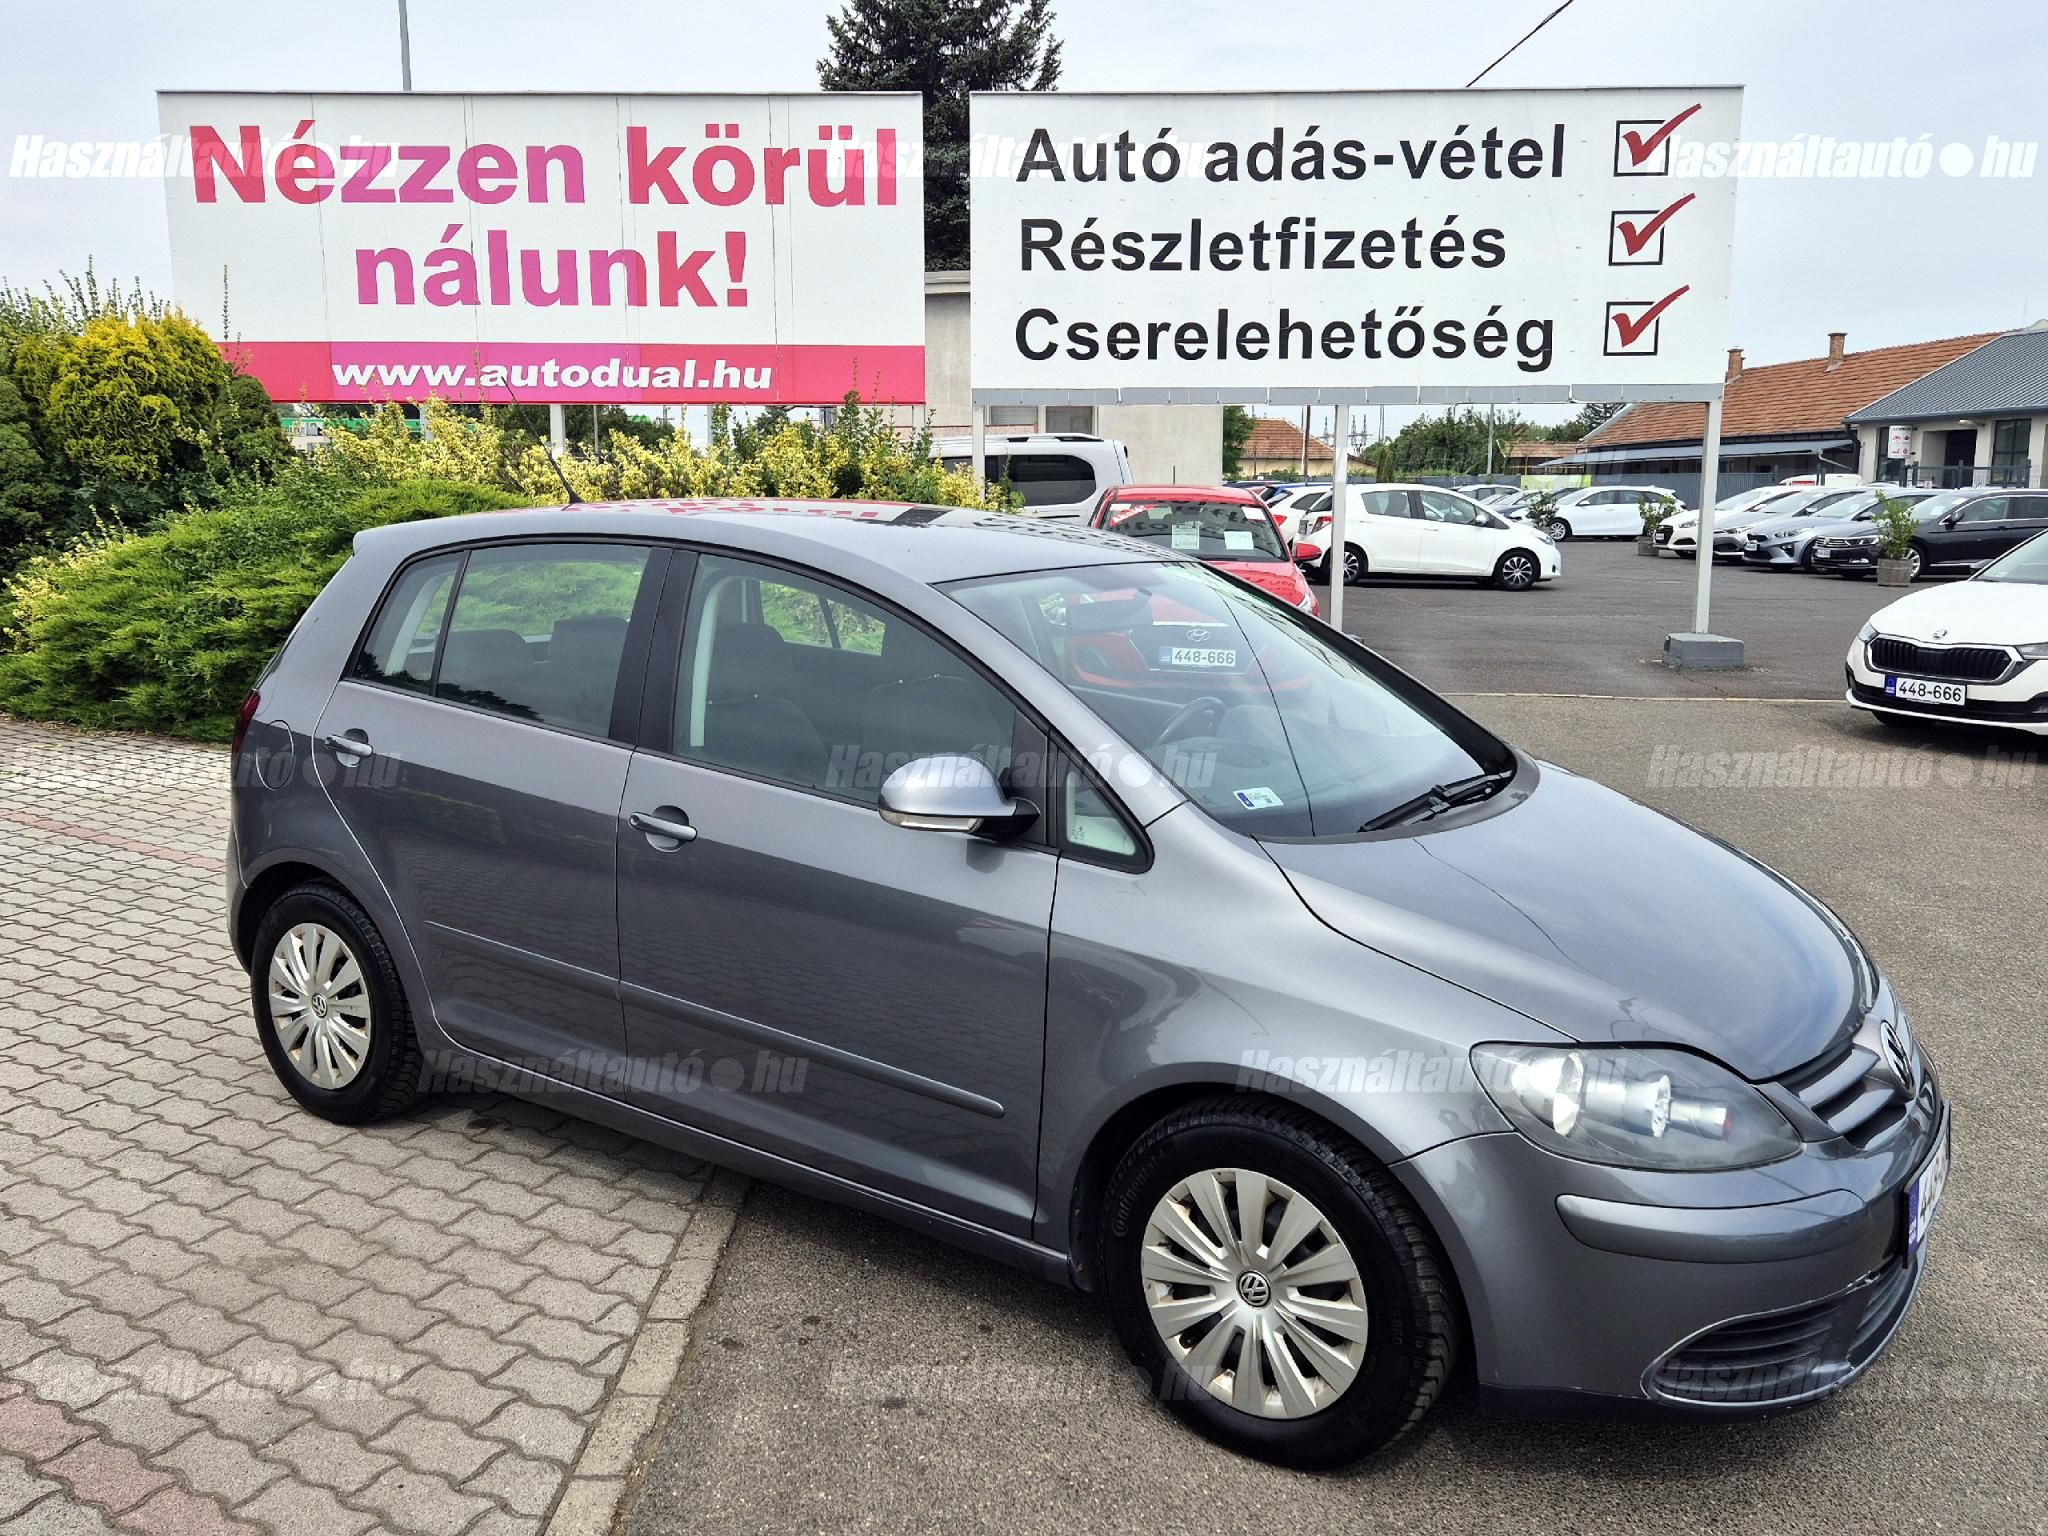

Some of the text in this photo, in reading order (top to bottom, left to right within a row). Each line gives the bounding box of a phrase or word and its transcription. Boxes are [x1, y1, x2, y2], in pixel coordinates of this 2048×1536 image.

[190, 119, 897, 208] Nézzen körül
[1015, 123, 1565, 183] Autó adás-vétel
[355, 223, 748, 307] nálunk!
[1021, 214, 1506, 272] Részletfizetés
[1015, 305, 1553, 373] Cserelehetőség
[331, 357, 772, 391] www.autodual.hu
[1174, 649, 1235, 665] 448-666
[1899, 680, 1962, 702] 448-666
